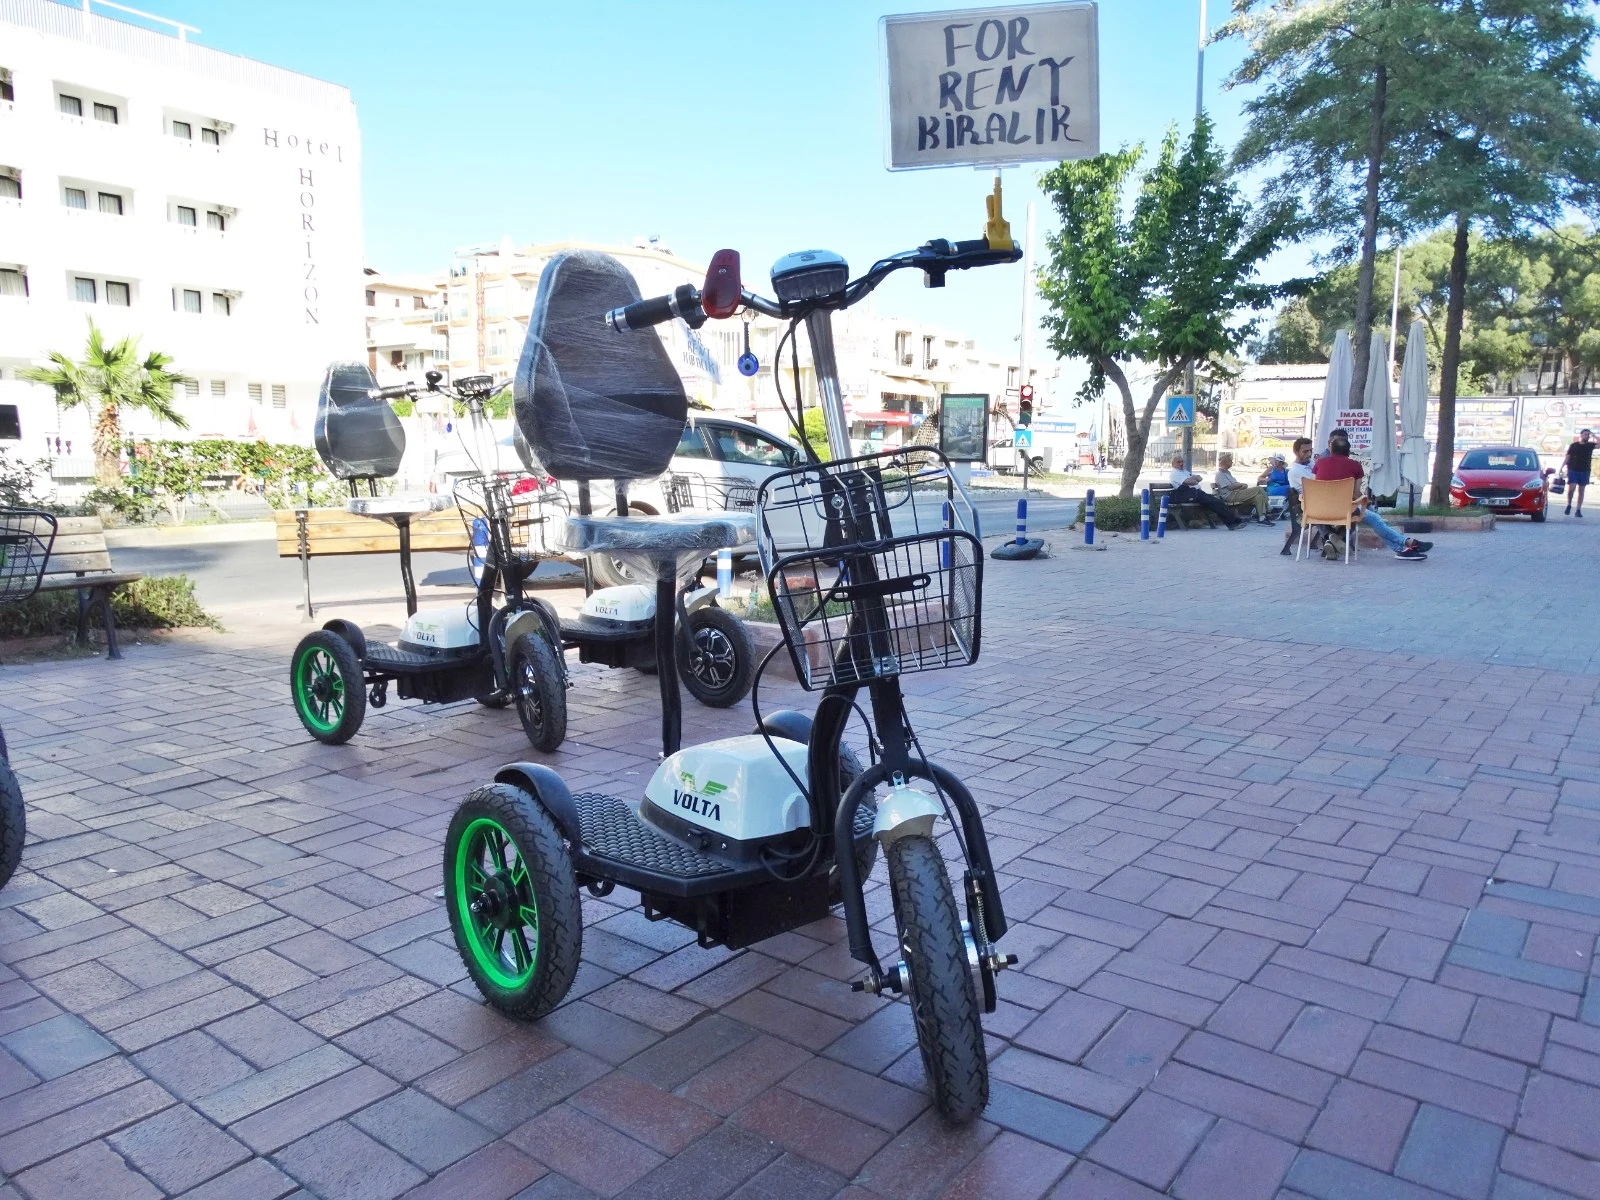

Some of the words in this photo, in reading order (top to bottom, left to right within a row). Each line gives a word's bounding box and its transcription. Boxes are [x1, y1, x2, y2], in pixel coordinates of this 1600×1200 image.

[943, 16, 1036, 67] FOR
[938, 55, 1076, 112] RENT
[263, 127, 342, 163] Hotel
[673, 789, 721, 821] VOLTA
